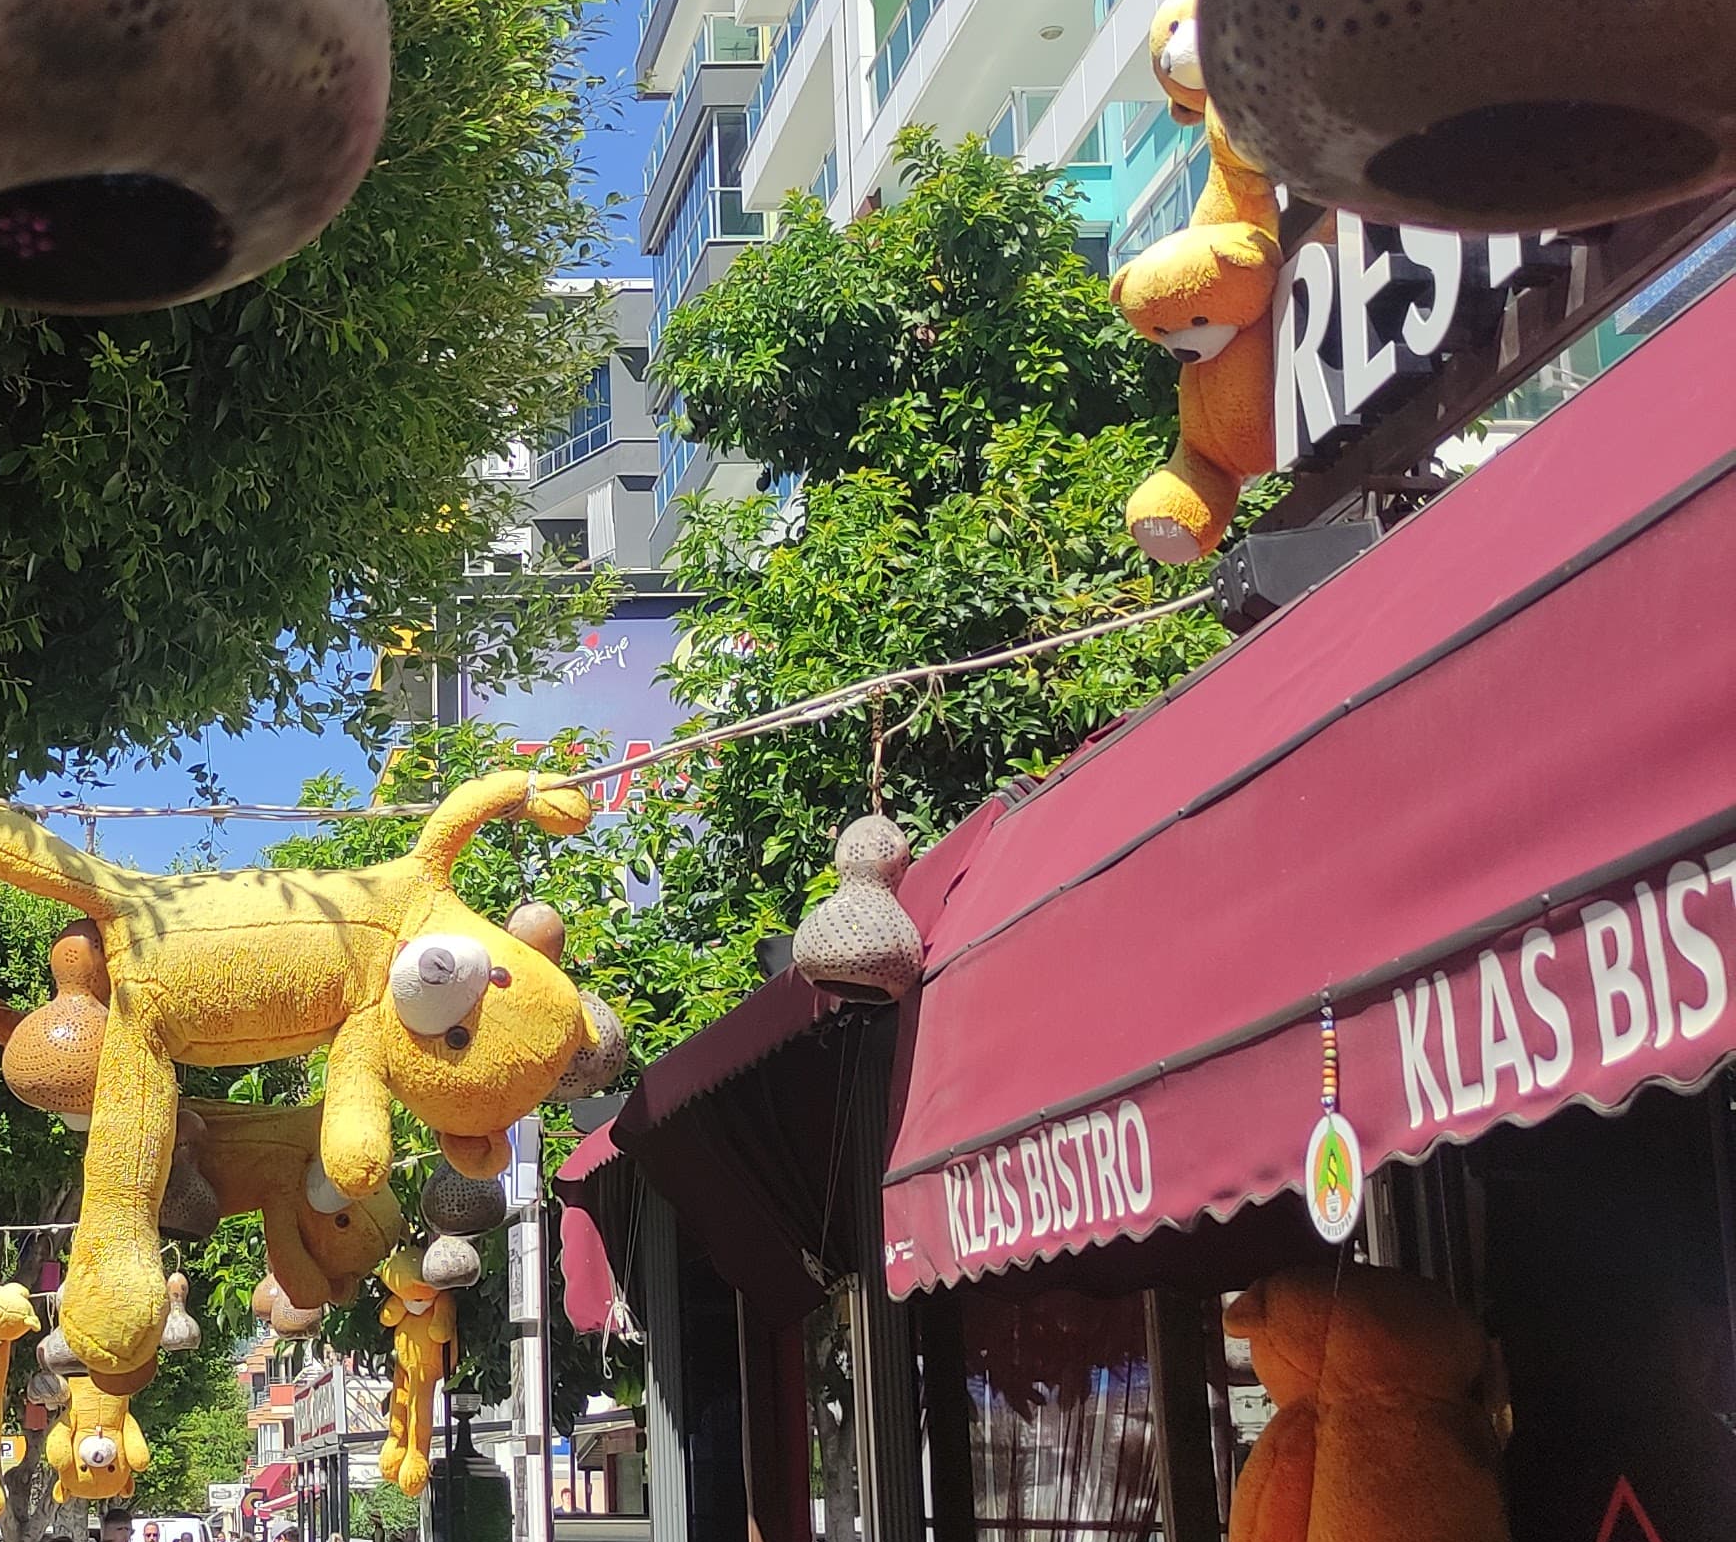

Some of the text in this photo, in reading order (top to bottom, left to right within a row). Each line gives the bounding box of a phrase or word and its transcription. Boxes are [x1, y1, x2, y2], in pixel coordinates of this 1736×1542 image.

[563, 636, 629, 685] Türkiye
[1392, 926, 1573, 1129] KLAS
[943, 1099, 1153, 1261] KLAS BISTRO
[0, 1442, 12, 1457] P
